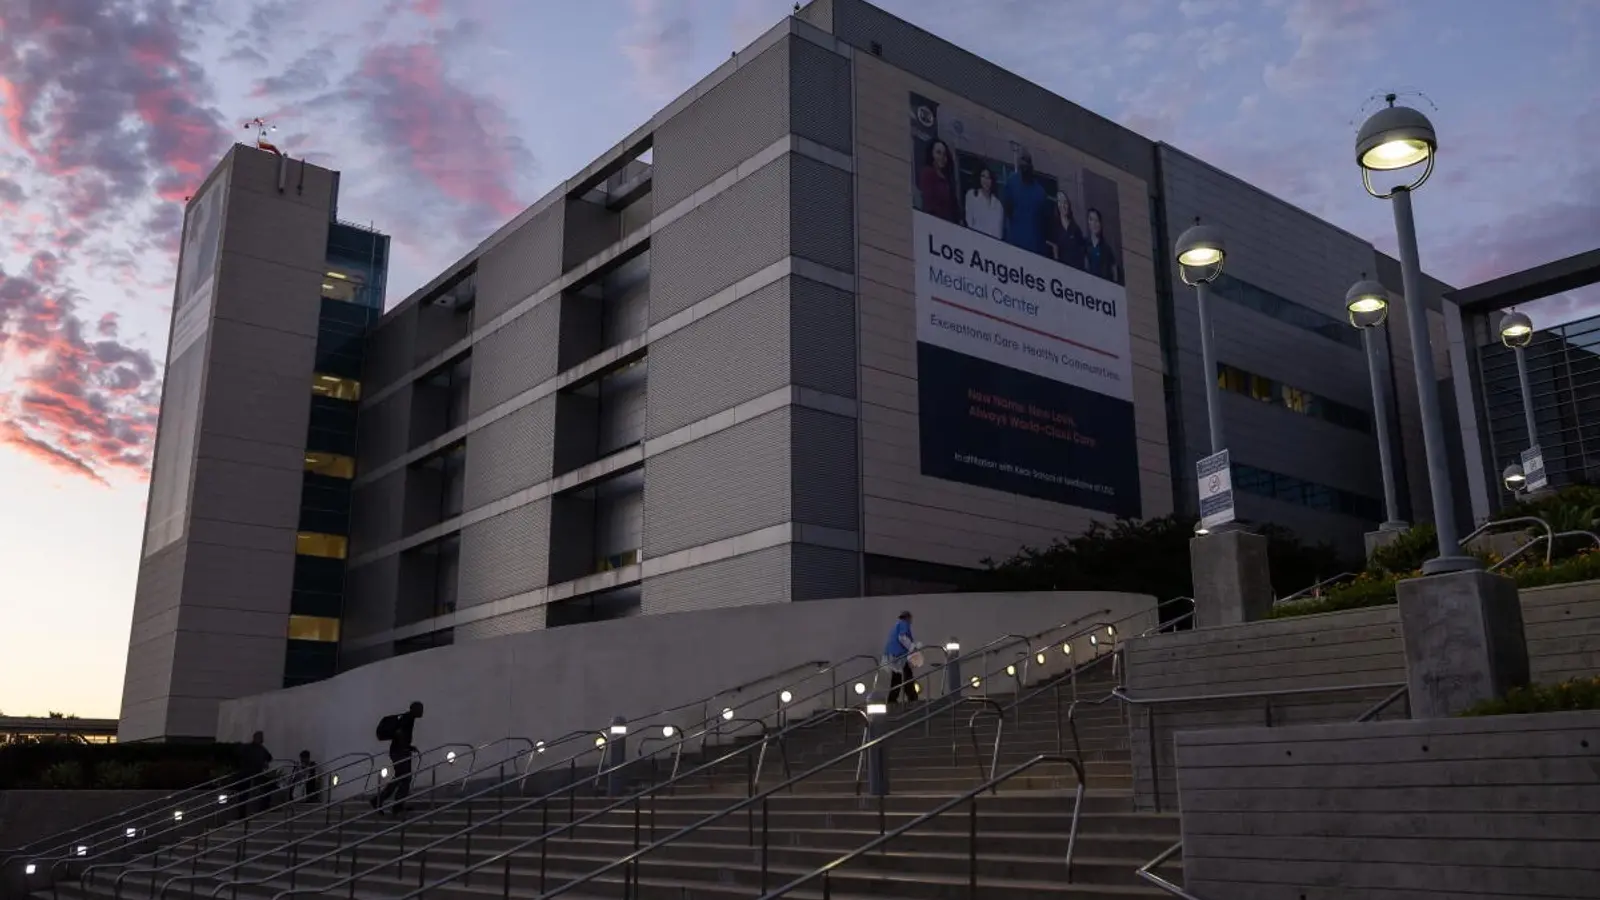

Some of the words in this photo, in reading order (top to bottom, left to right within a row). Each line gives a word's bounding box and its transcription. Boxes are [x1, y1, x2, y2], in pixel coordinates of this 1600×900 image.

[929, 233, 964, 264] Los
[970, 249, 1045, 292] Angeles
[1051, 279, 1116, 317] General
[930, 265, 988, 300] Medical
[992, 287, 1039, 316] Center
[931, 313, 991, 342] Exceptional
